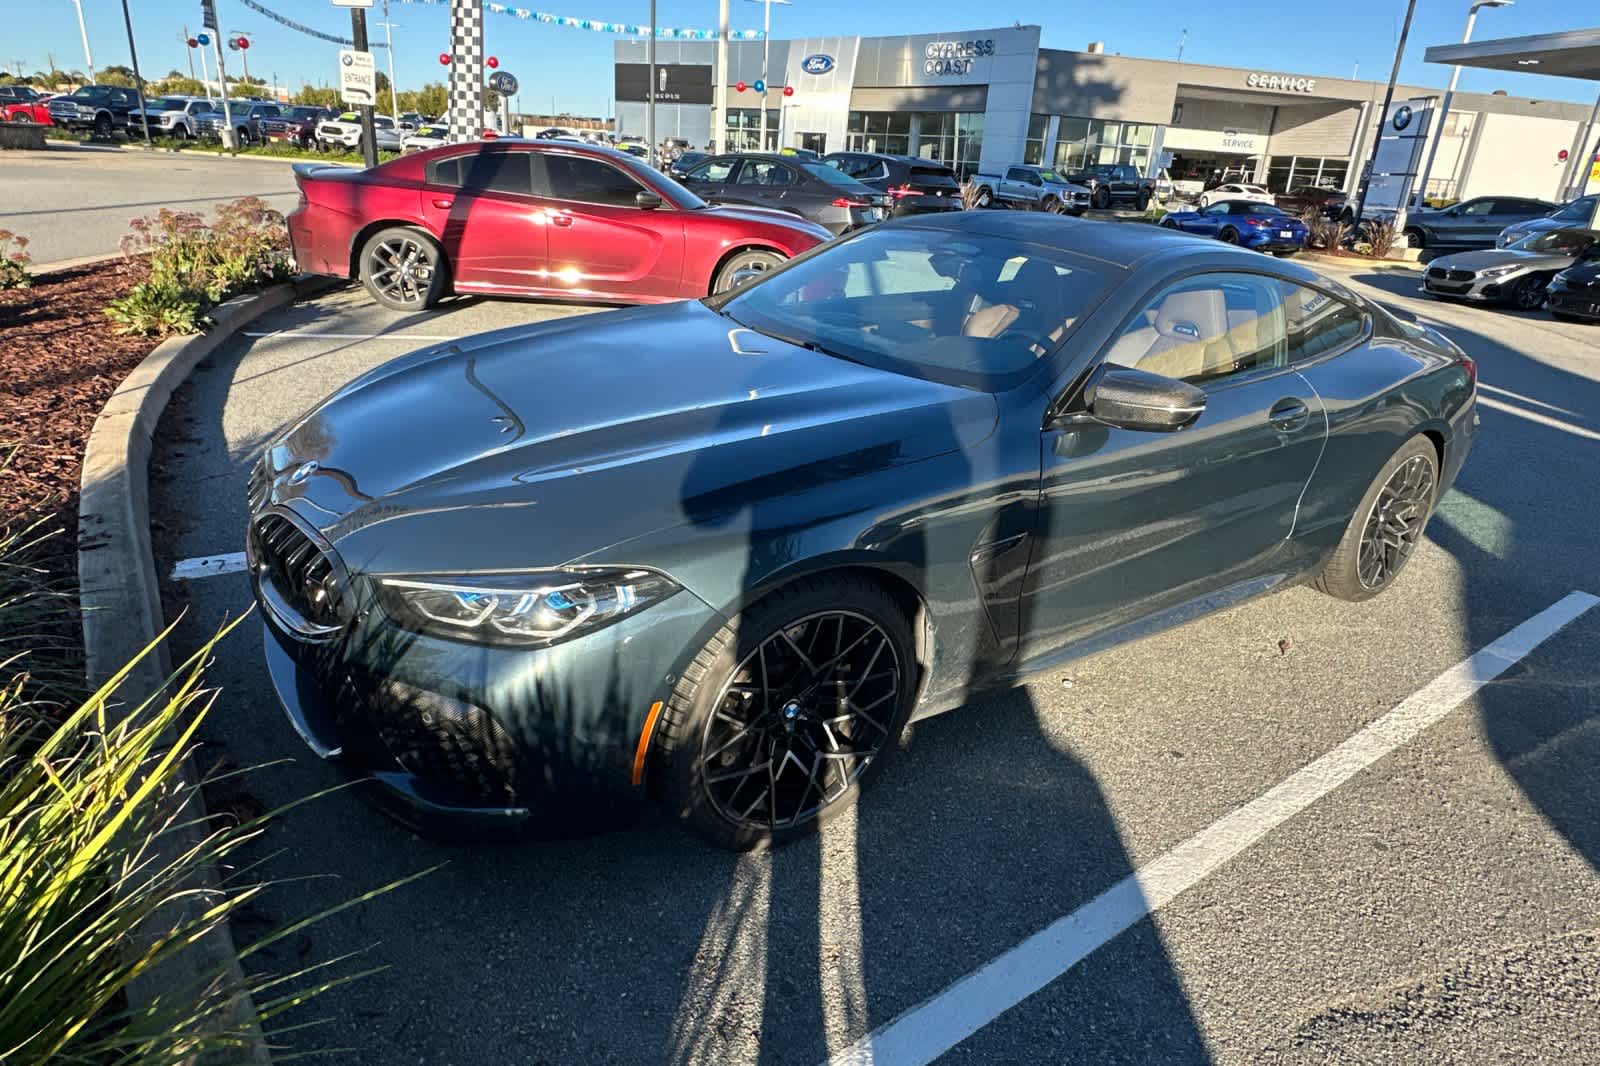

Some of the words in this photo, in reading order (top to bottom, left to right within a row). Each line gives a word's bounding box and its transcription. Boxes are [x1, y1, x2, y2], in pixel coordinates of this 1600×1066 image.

[926, 40, 994, 58] CYPRESS
[924, 60, 973, 76] COAST
[344, 72, 372, 86] ENTRANCE
[1247, 73, 1316, 92] SERVICE
[1222, 138, 1254, 149] SERVICE
